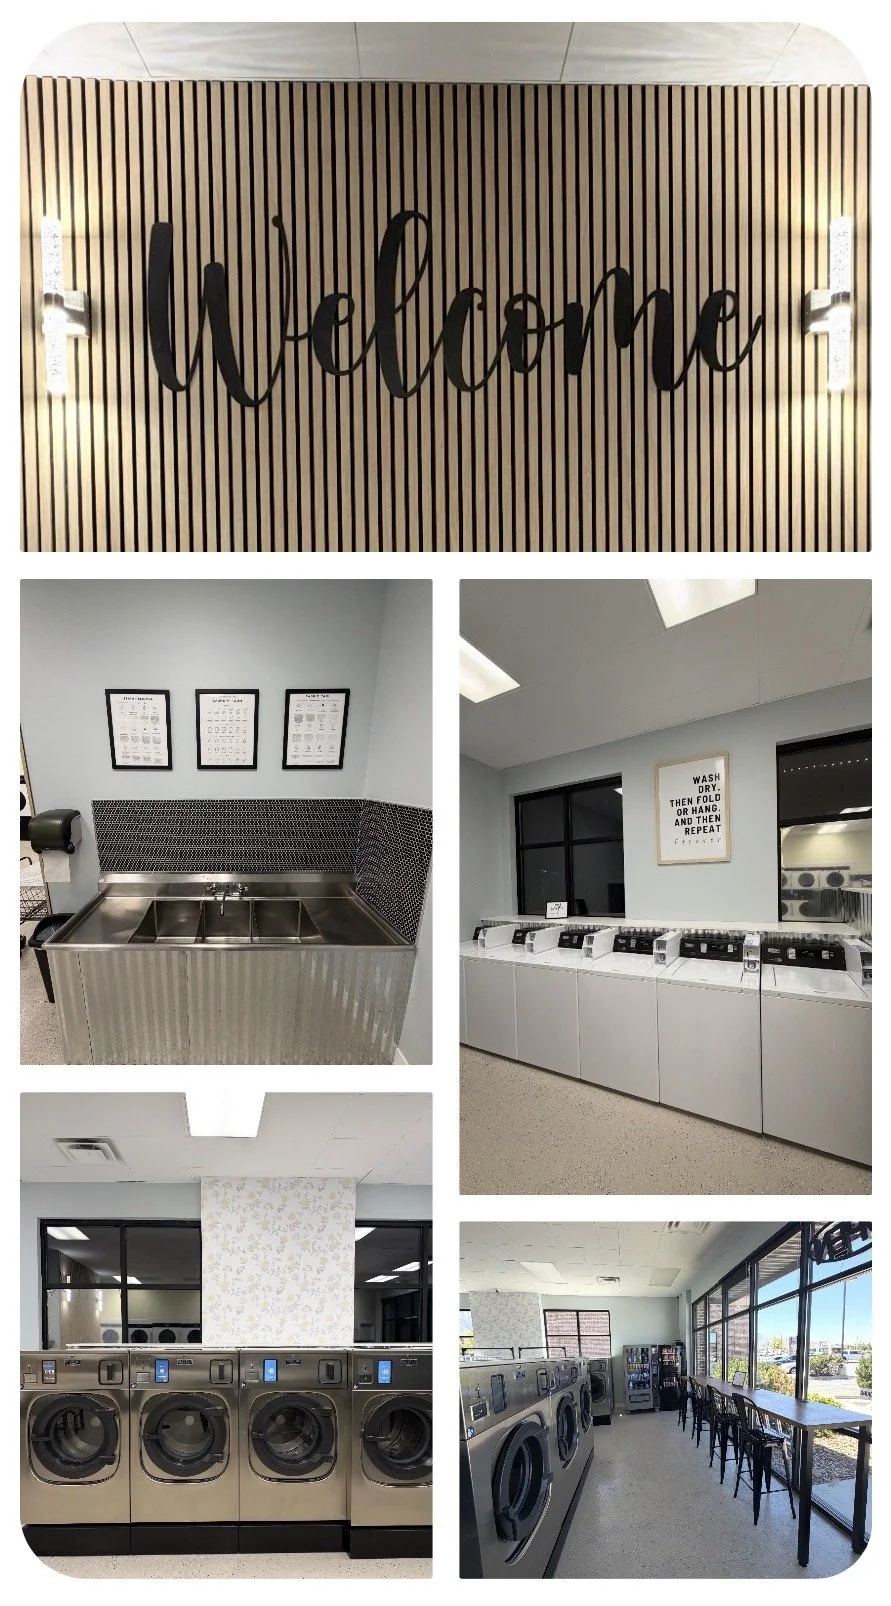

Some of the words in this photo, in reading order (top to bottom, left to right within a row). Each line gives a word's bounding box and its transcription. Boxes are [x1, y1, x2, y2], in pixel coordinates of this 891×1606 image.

[148, 210, 763, 408] Welcome
[692, 773, 721, 784] WASH
[698, 783, 721, 793] DRY.
[669, 797, 693, 807] THEN
[696, 794, 721, 804] FOLD
[676, 807, 689, 816] OR
[691, 804, 721, 815] HANG.
[674, 817, 693, 826] AND
[695, 814, 721, 824] THEN
[684, 825, 722, 835] REPEAT
